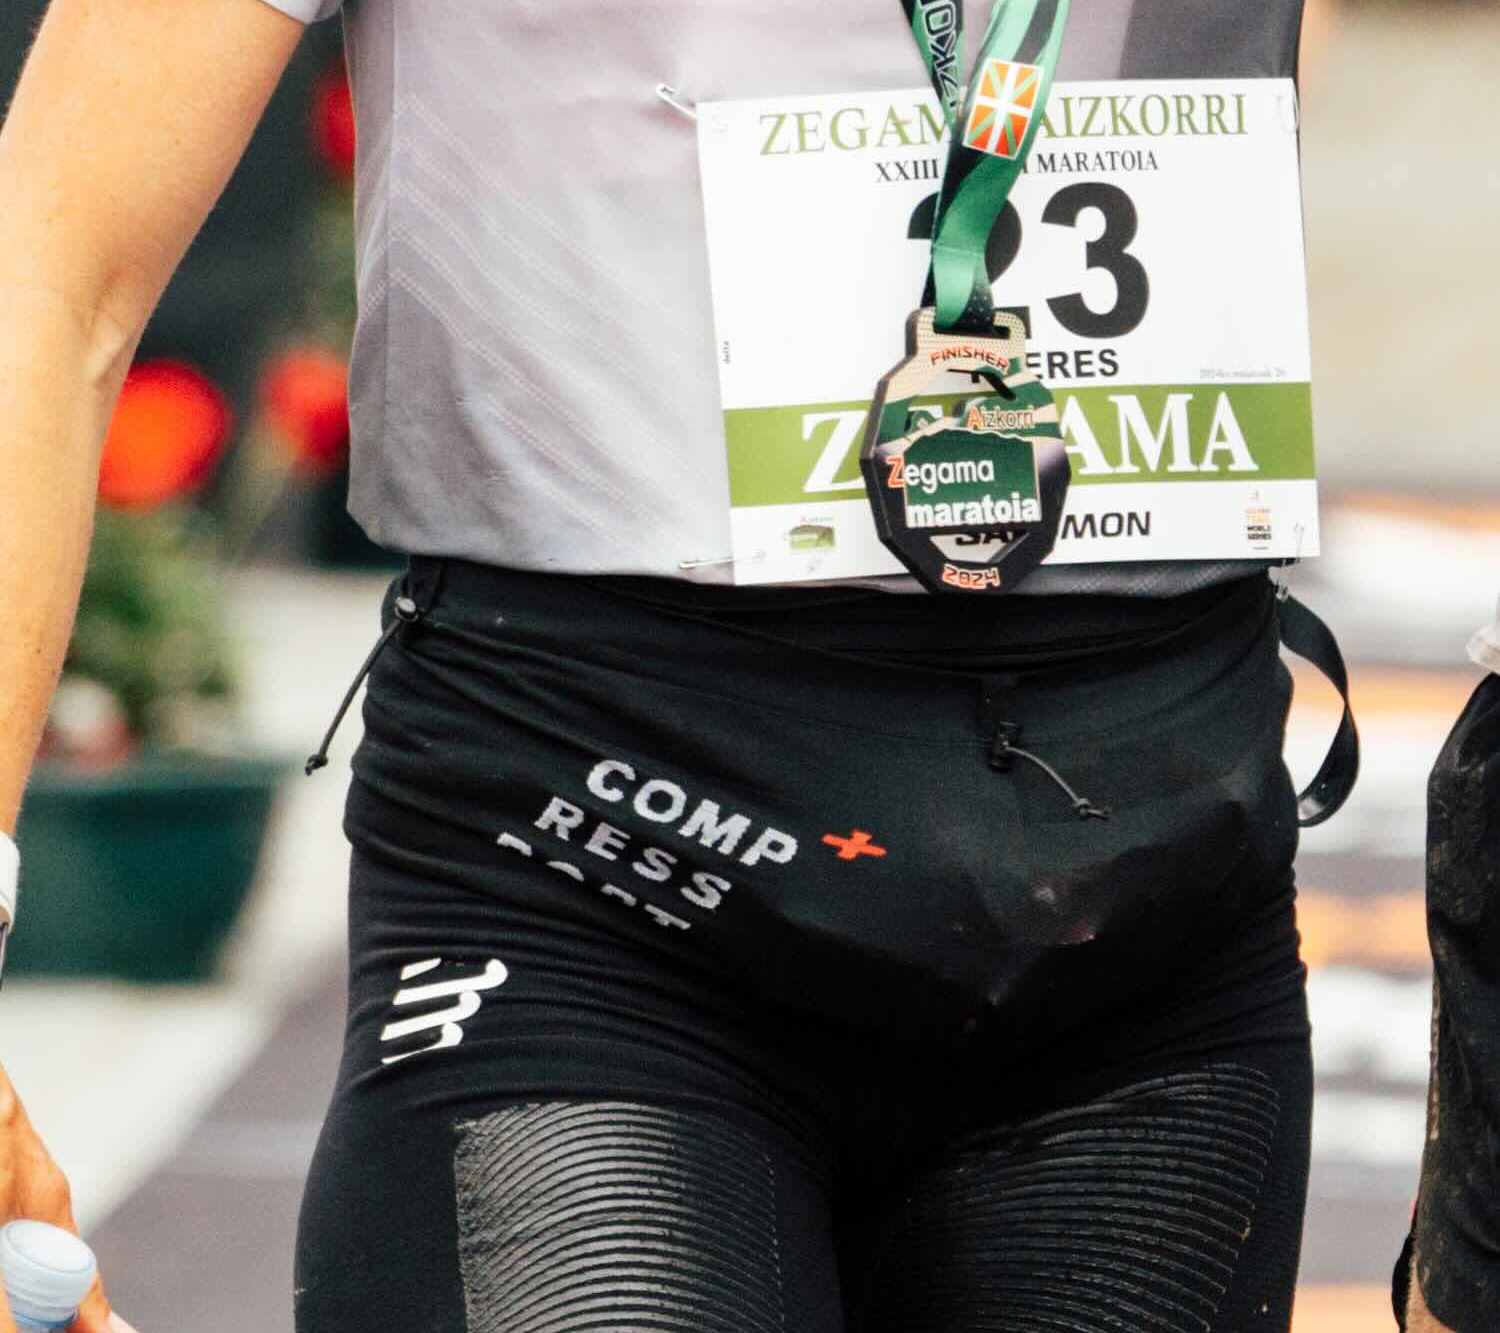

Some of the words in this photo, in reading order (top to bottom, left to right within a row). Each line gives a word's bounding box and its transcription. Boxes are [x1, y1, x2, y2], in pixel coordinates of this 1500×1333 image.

[1036, 149, 1160, 175] MARATOIA
[929, 345, 1010, 371] FINISHER
[1026, 347, 1121, 381] ERES
[886, 456, 996, 494] Zegama
[905, 491, 1041, 530] maratoia
[941, 563, 1002, 590] 2024
[585, 758, 800, 871] COMP
[532, 795, 733, 915] RESS
